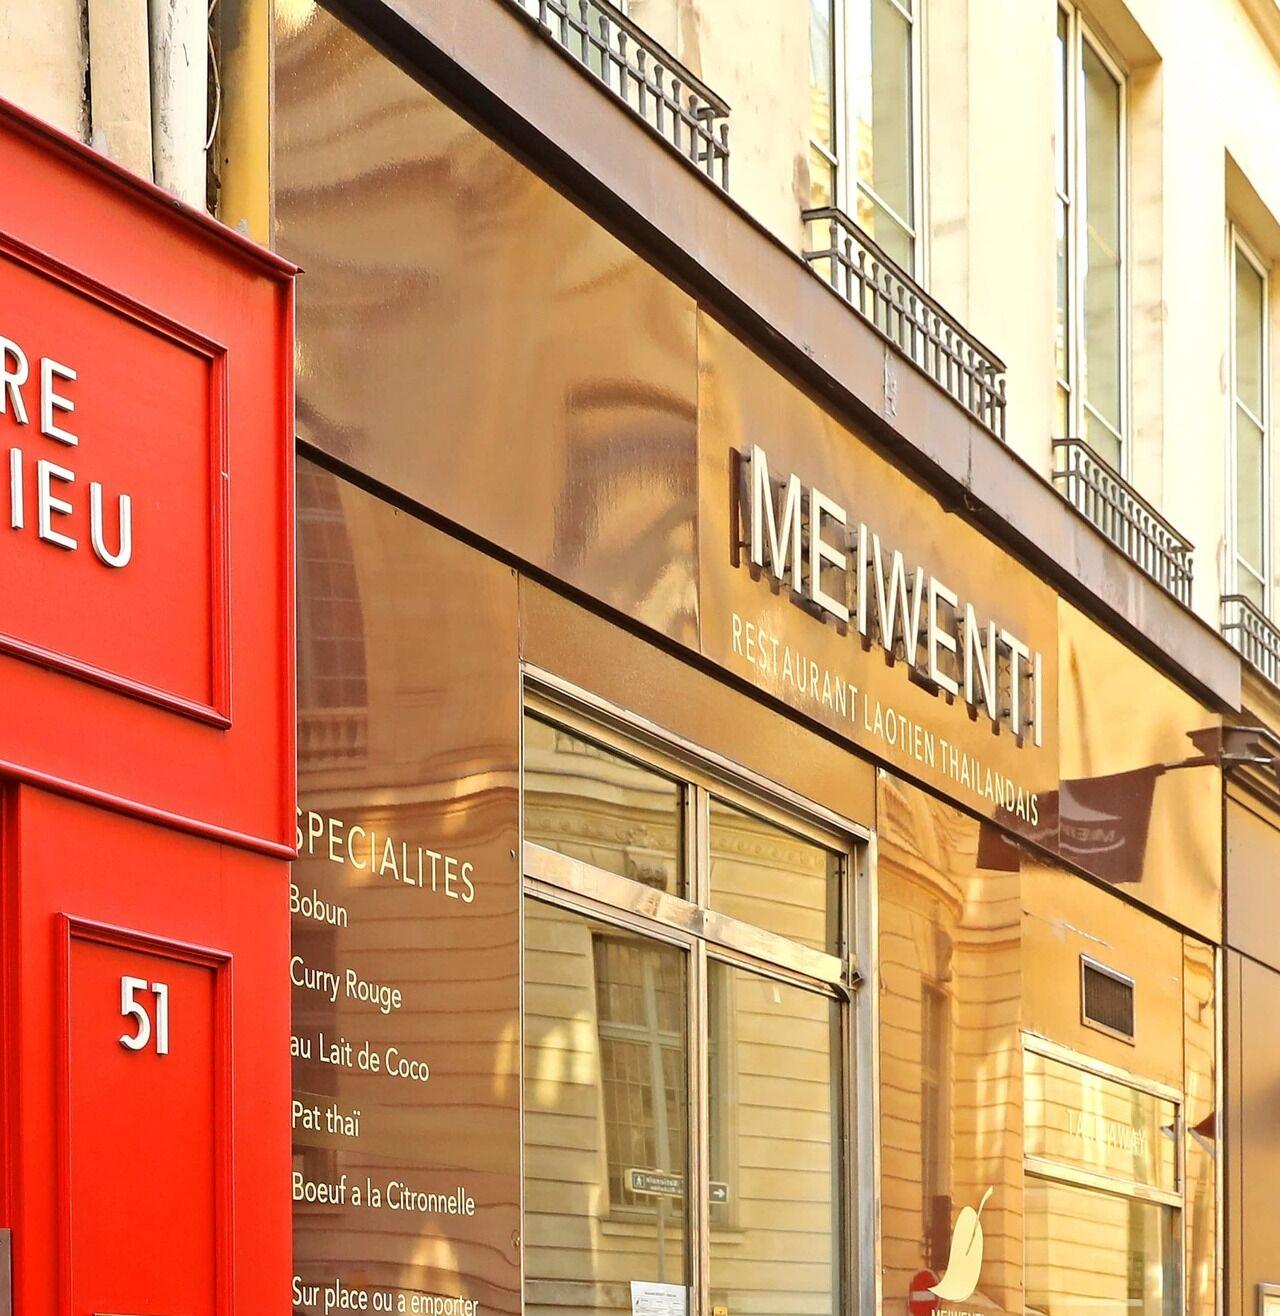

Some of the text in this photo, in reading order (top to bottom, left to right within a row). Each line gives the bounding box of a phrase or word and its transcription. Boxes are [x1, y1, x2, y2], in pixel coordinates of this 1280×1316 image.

[750, 443, 1042, 748] MEIWENTI
[731, 612, 1039, 827] RESTAURANT LAOTIEN THAILANDAIS
[290, 884, 348, 928] Bobun
[289, 955, 403, 1015] Curry Rouge
[119, 975, 170, 1055] 51
[289, 1032, 430, 1082] au Lait de Coco
[292, 1100, 362, 1137] Pat thaï
[292, 1171, 475, 1216] Boeuf a la Citronnelle
[292, 1276, 320, 1306] Sur
[324, 1279, 368, 1316] place
[373, 1287, 393, 1313] ou
[397, 1289, 407, 1314] a
